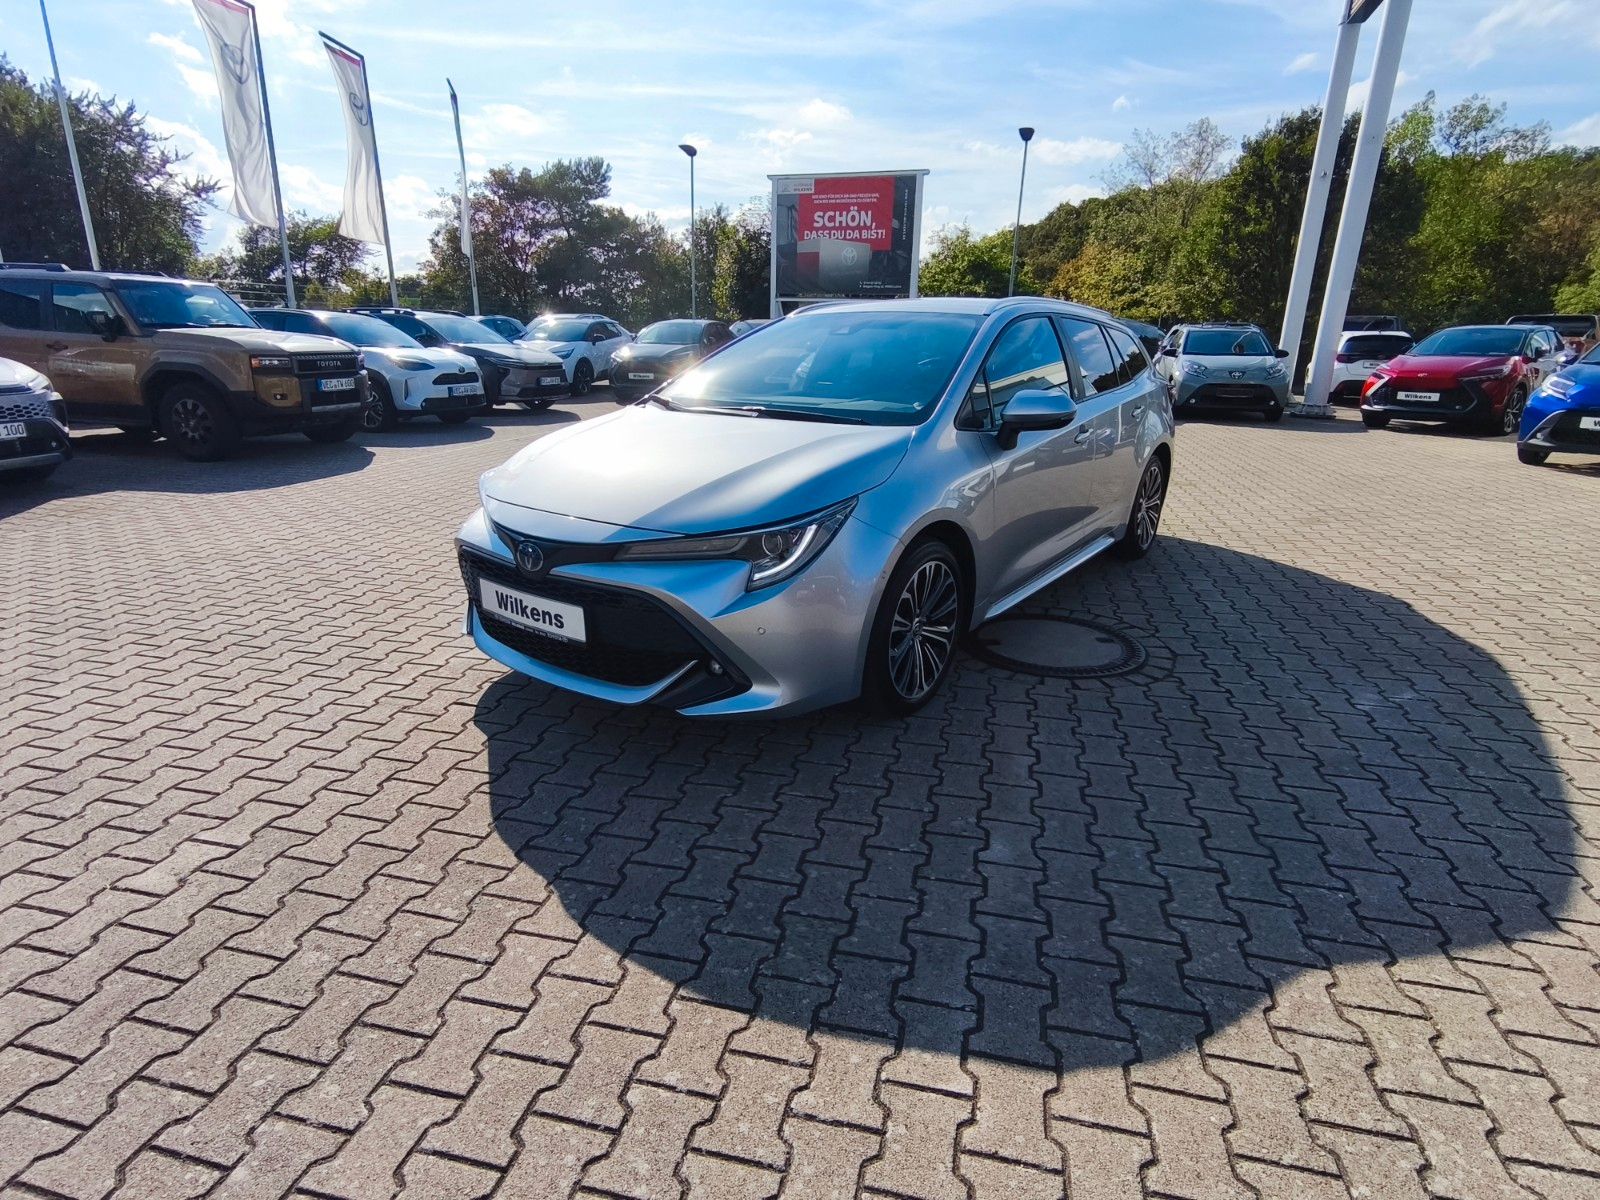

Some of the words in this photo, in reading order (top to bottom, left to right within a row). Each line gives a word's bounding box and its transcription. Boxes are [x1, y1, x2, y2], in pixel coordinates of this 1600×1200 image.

[813, 205, 876, 230] SCHÖN,
[804, 230, 829, 240] DASS
[831, 230, 844, 240] DU
[846, 229, 859, 239] DA
[861, 229, 886, 239] BIST!
[3, 424, 25, 436] 100
[495, 589, 565, 629] Wilkens
